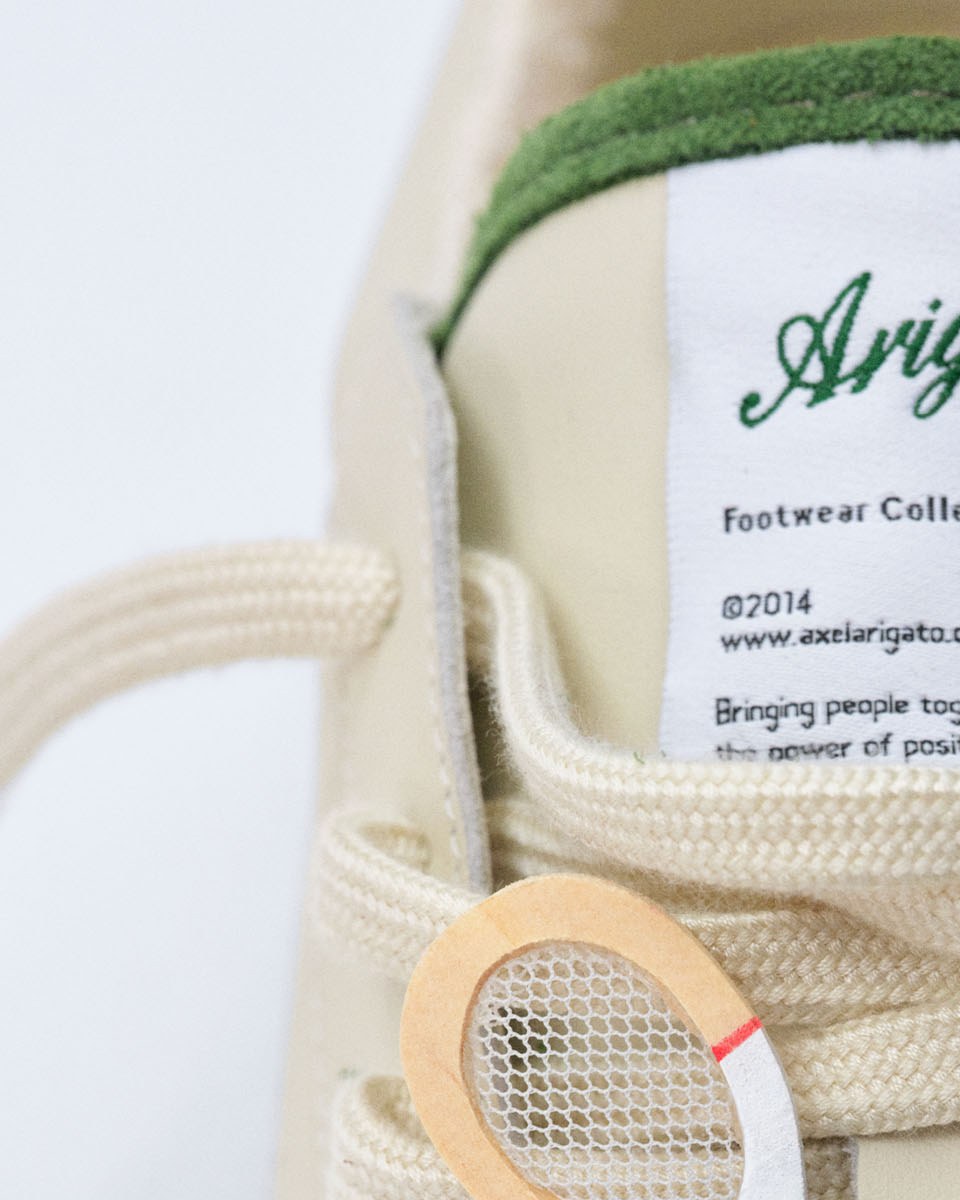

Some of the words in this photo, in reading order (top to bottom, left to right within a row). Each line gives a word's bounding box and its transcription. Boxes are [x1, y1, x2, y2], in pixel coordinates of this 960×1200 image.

[723, 502, 867, 534] Footwear
[721, 588, 813, 620] ©2014
[715, 696, 815, 732] Bringing
[825, 692, 910, 725] people
[863, 732, 894, 758] of
